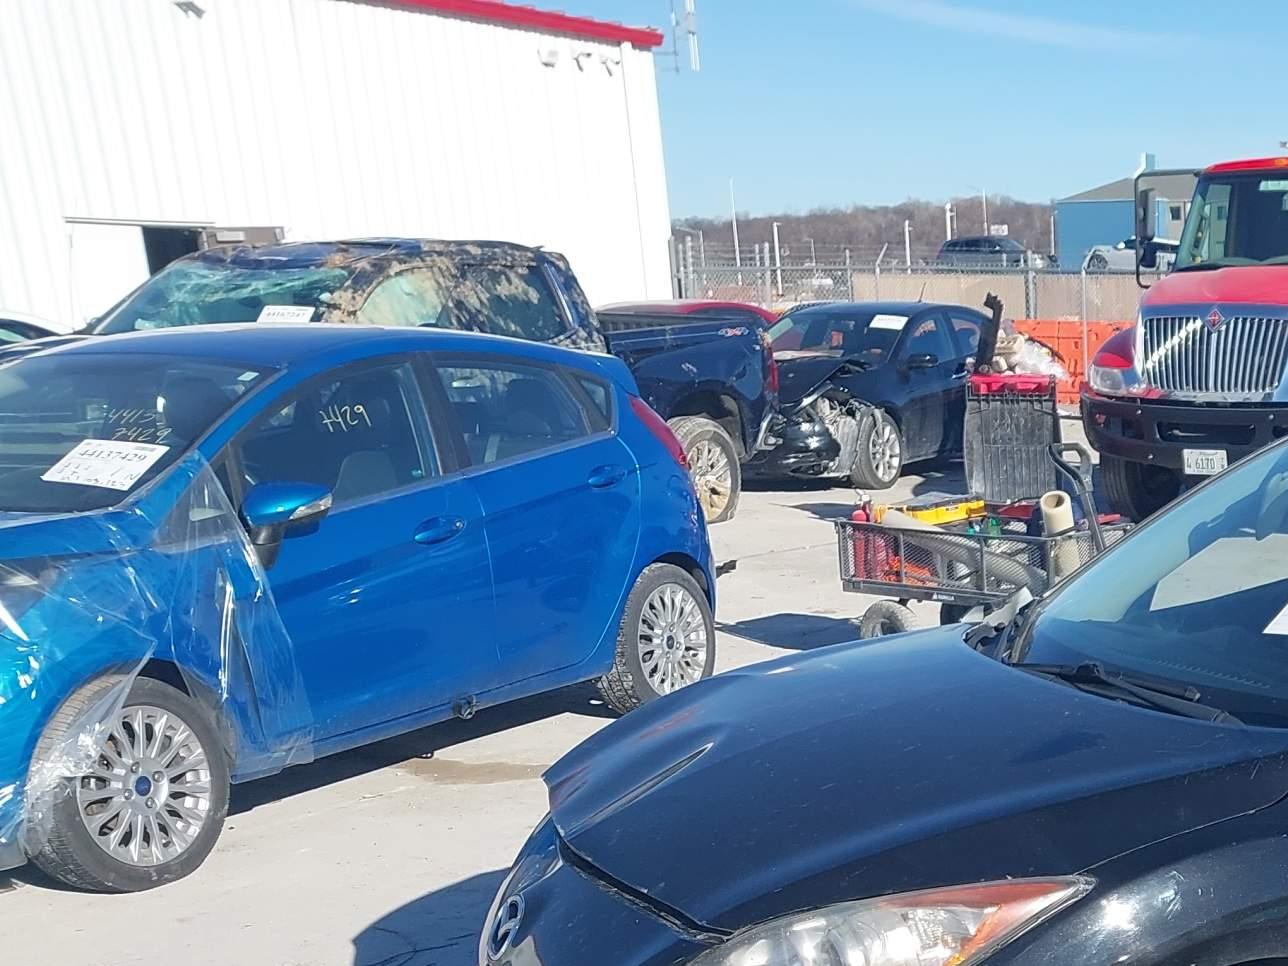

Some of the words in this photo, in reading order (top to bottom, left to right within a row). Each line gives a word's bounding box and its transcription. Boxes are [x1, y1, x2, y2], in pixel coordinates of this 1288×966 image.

[319, 403, 372, 433] 7429
[111, 426, 173, 444] 7429
[79, 448, 148, 462] 44137429
